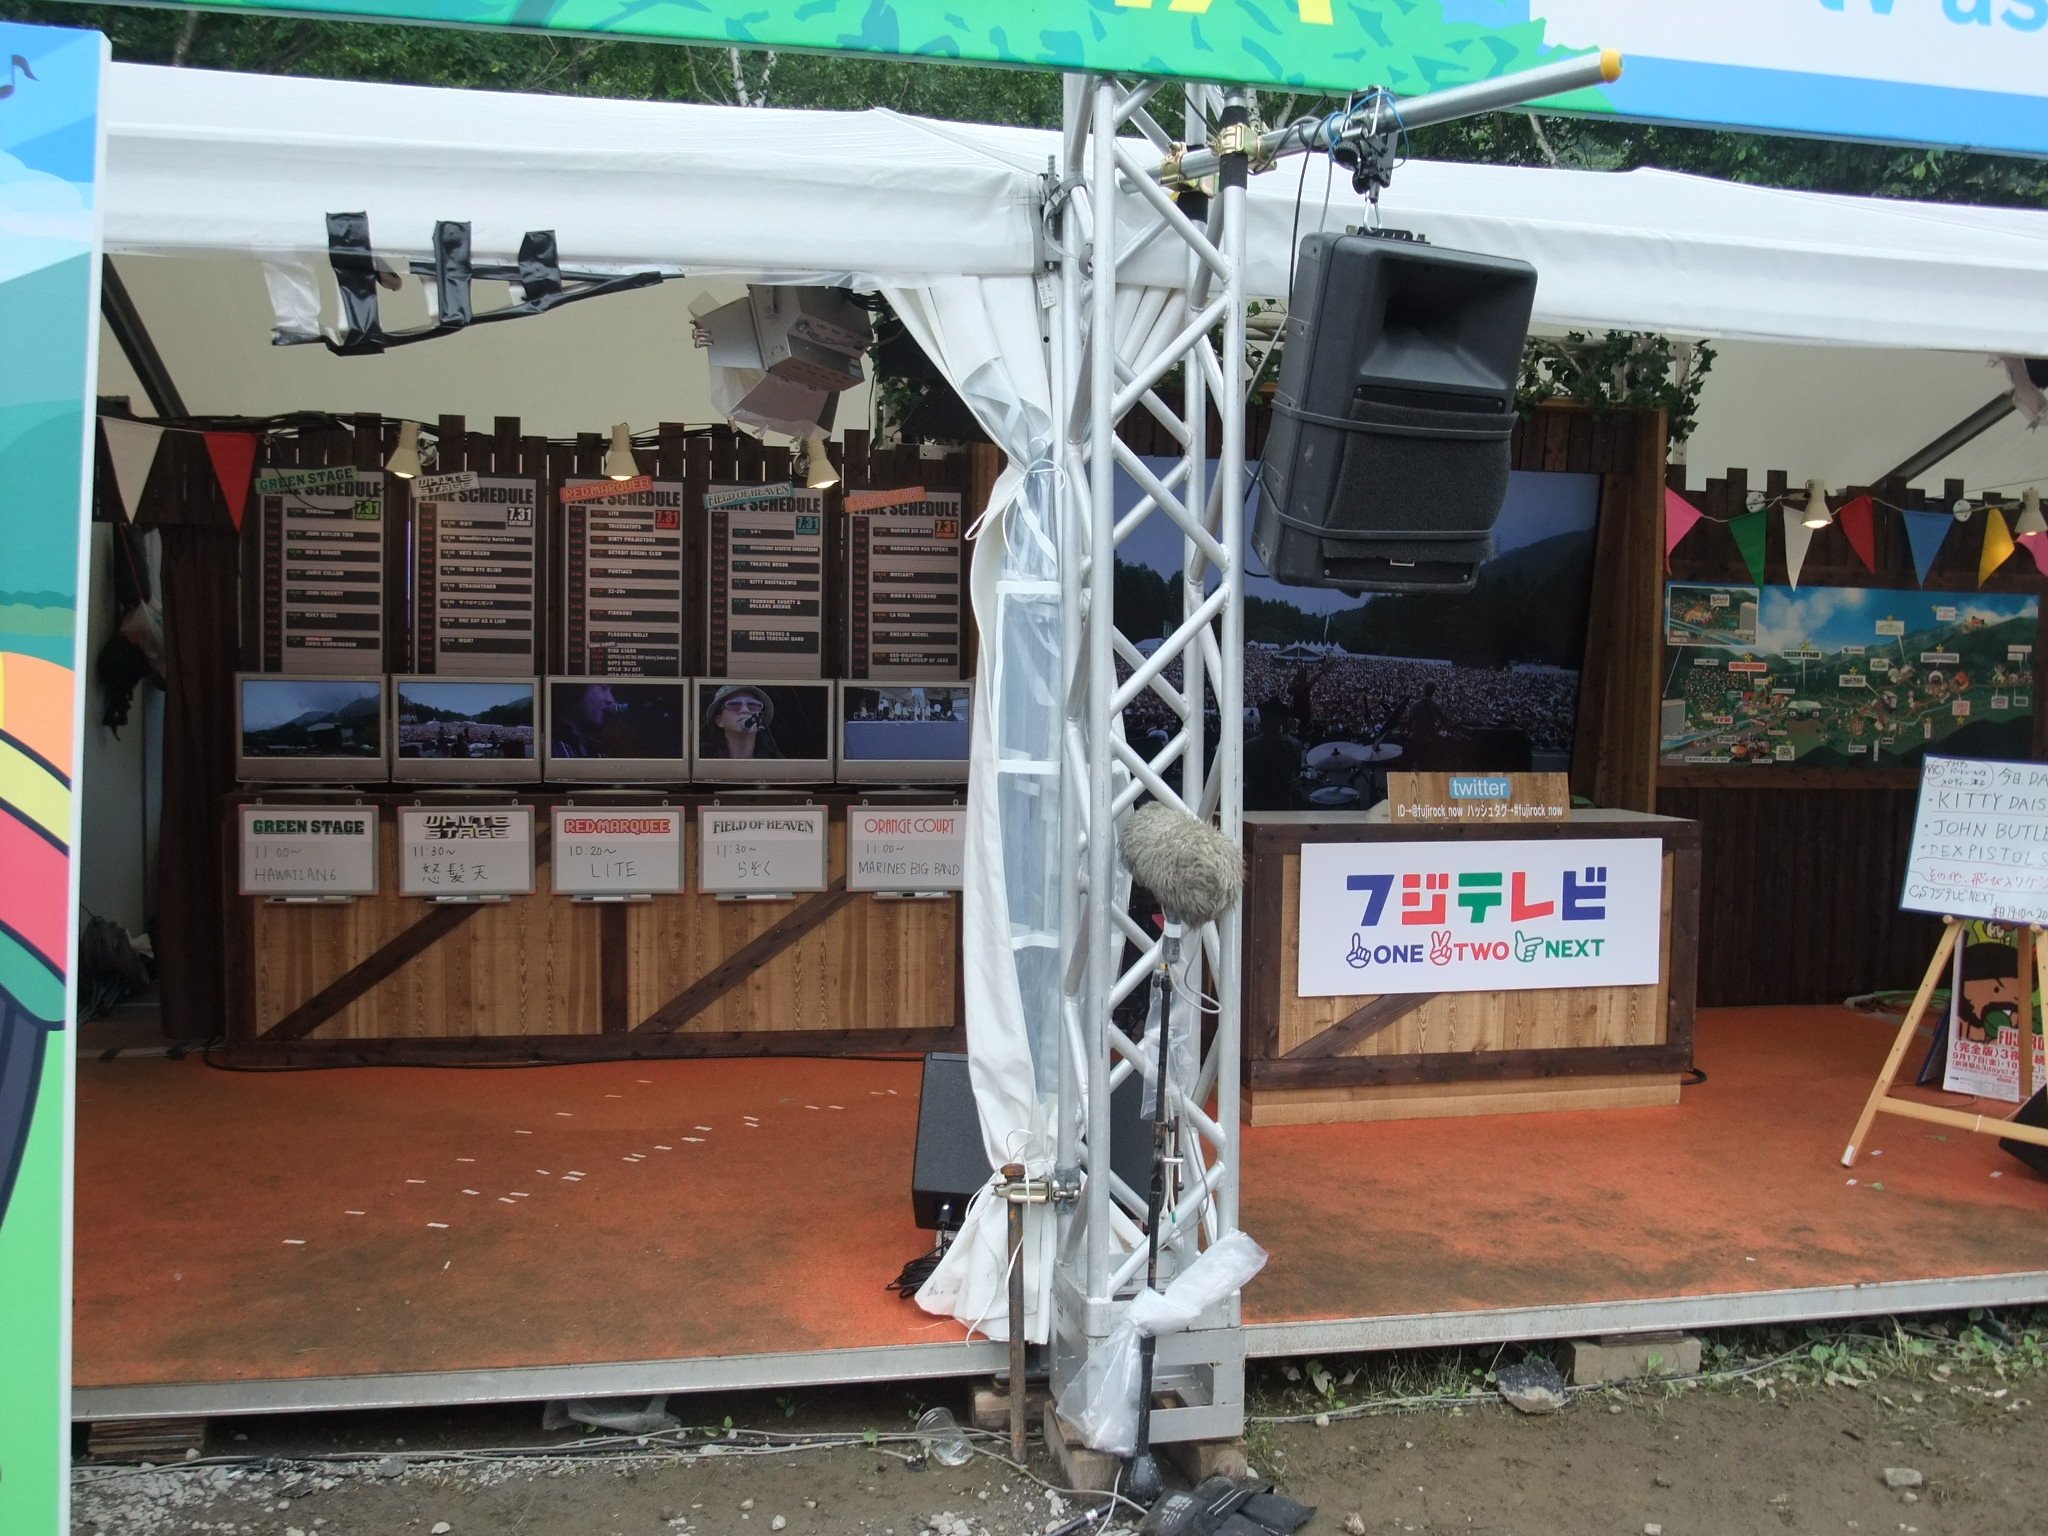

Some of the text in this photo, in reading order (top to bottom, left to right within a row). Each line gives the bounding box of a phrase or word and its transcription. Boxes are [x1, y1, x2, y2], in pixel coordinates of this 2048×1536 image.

[259, 468, 353, 491] GREEN STAGE
[459, 488, 534, 504] SCHEDULE
[608, 491, 681, 507] SCHEDULE
[708, 492, 735, 506] FIELD
[750, 484, 790, 498] HEAVEN
[749, 497, 821, 513] SCHEDULE
[889, 502, 959, 517] SCHEDULE
[508, 508, 532, 521] 7.31
[796, 516, 819, 529] 7.31
[935, 520, 958, 533] 7.31
[1453, 779, 1507, 796] twitter
[1938, 790, 2003, 810] KITTY
[253, 819, 365, 835] GREEN STAGE
[713, 819, 814, 834] FIELD OF HEAVEN
[864, 818, 956, 834] ORANGE COURT
[1932, 819, 1987, 837] JOHN
[591, 861, 637, 878] LITE
[858, 861, 960, 876] MARINES BIG BAND
[1347, 867, 1607, 926] フジテレビ
[1373, 938, 1605, 964] ONE TWO NEXT
